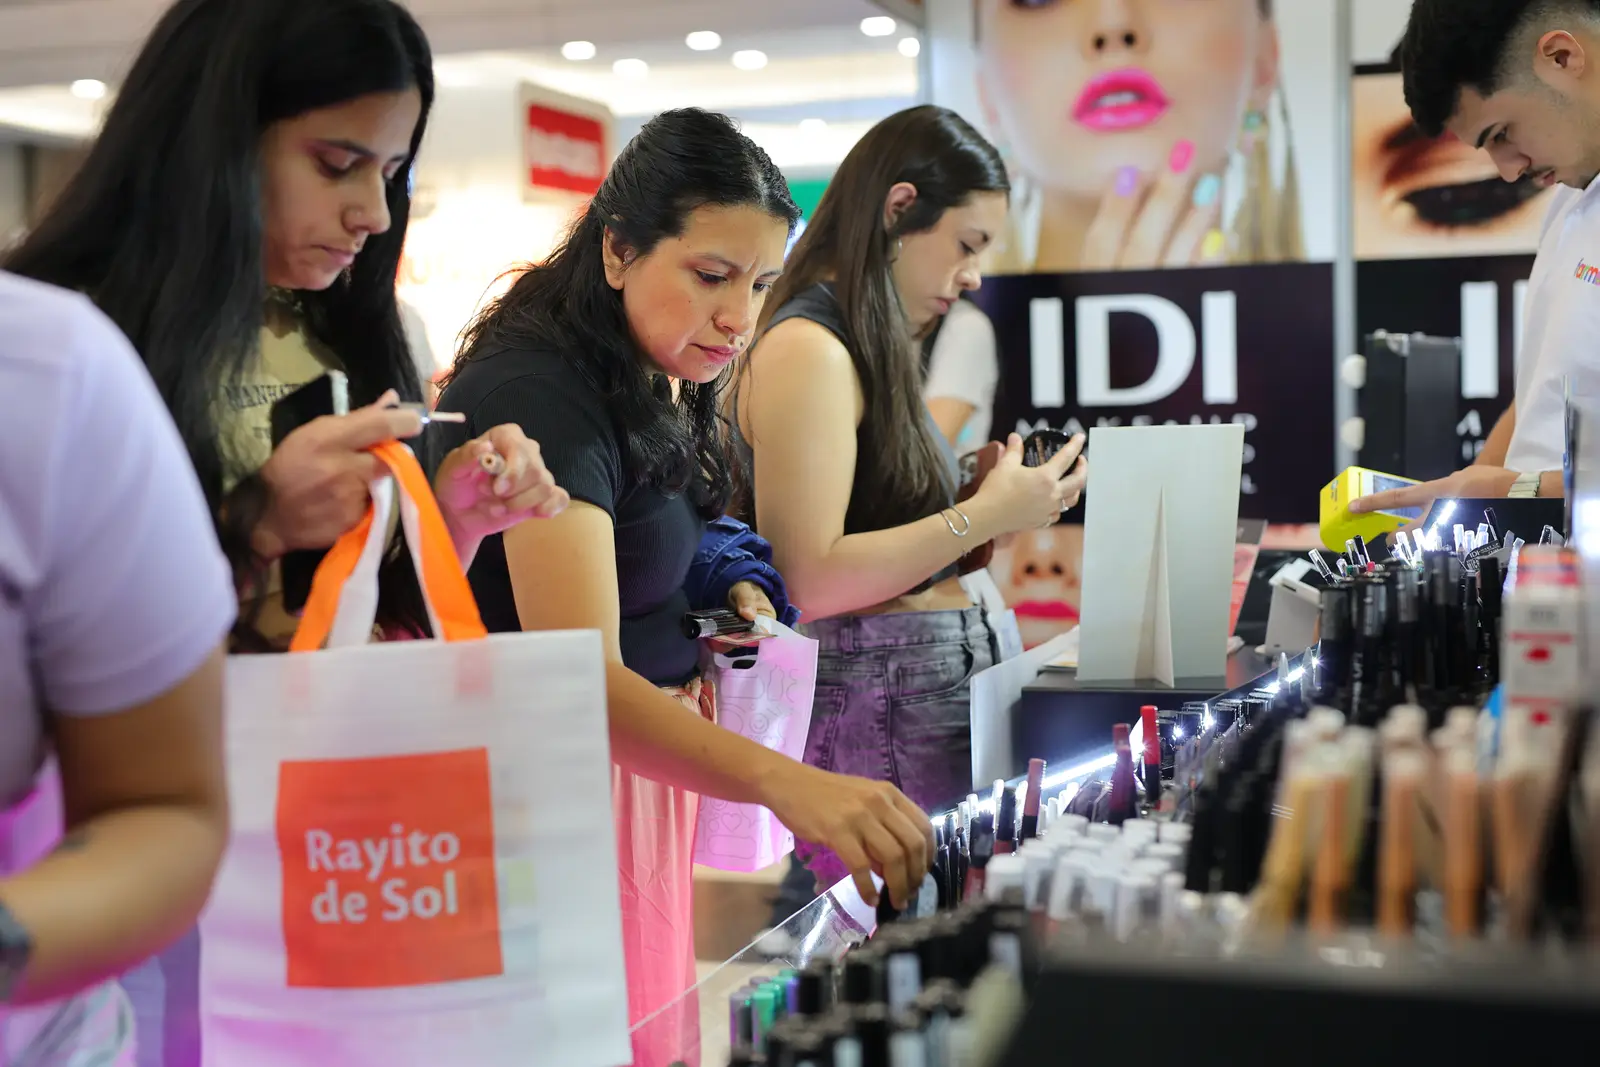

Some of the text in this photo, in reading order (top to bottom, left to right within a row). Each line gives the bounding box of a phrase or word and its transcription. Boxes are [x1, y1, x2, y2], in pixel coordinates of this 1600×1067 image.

[1029, 290, 1237, 408] IDI
[304, 823, 460, 882] Rayito
[311, 869, 459, 924] de Sol
